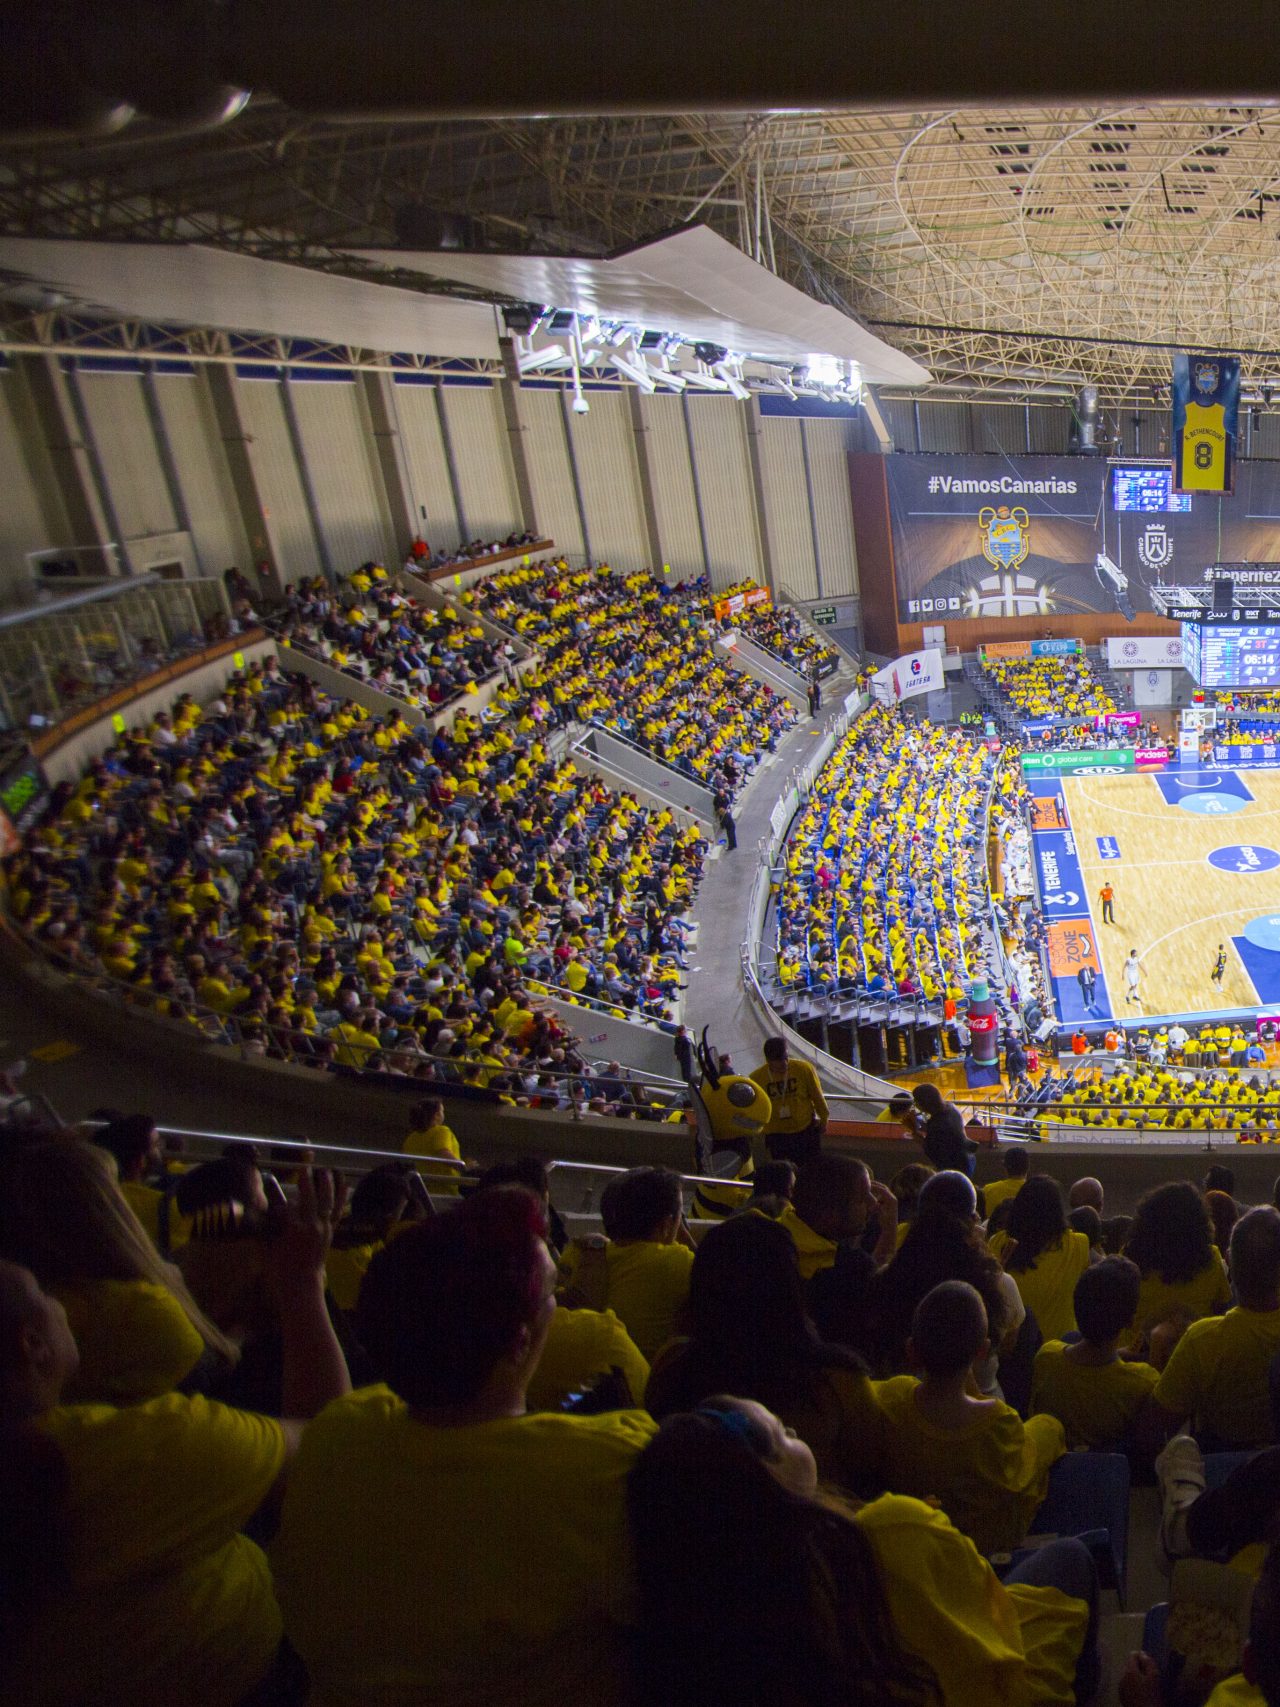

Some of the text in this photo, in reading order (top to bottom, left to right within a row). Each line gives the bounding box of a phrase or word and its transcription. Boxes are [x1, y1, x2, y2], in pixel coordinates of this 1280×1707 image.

[1190, 427, 1225, 441] BETHENCOURT
[1194, 441, 1213, 470] 8
[928, 476, 1077, 494] #VamosCanarias
[1138, 537, 1149, 565] CABILDO
[1159, 537, 1174, 568] TENERIFE
[1172, 610, 1202, 619] Tenerife
[1265, 627, 1276, 635] 61
[1244, 654, 1274, 664] 06:14
[1244, 666, 1253, 675] 4
[1057, 755, 1078, 764] global
[1081, 766, 1117, 774] KIA
[1041, 850, 1062, 890] TENERIFE
[1063, 929, 1081, 963] ZONE
